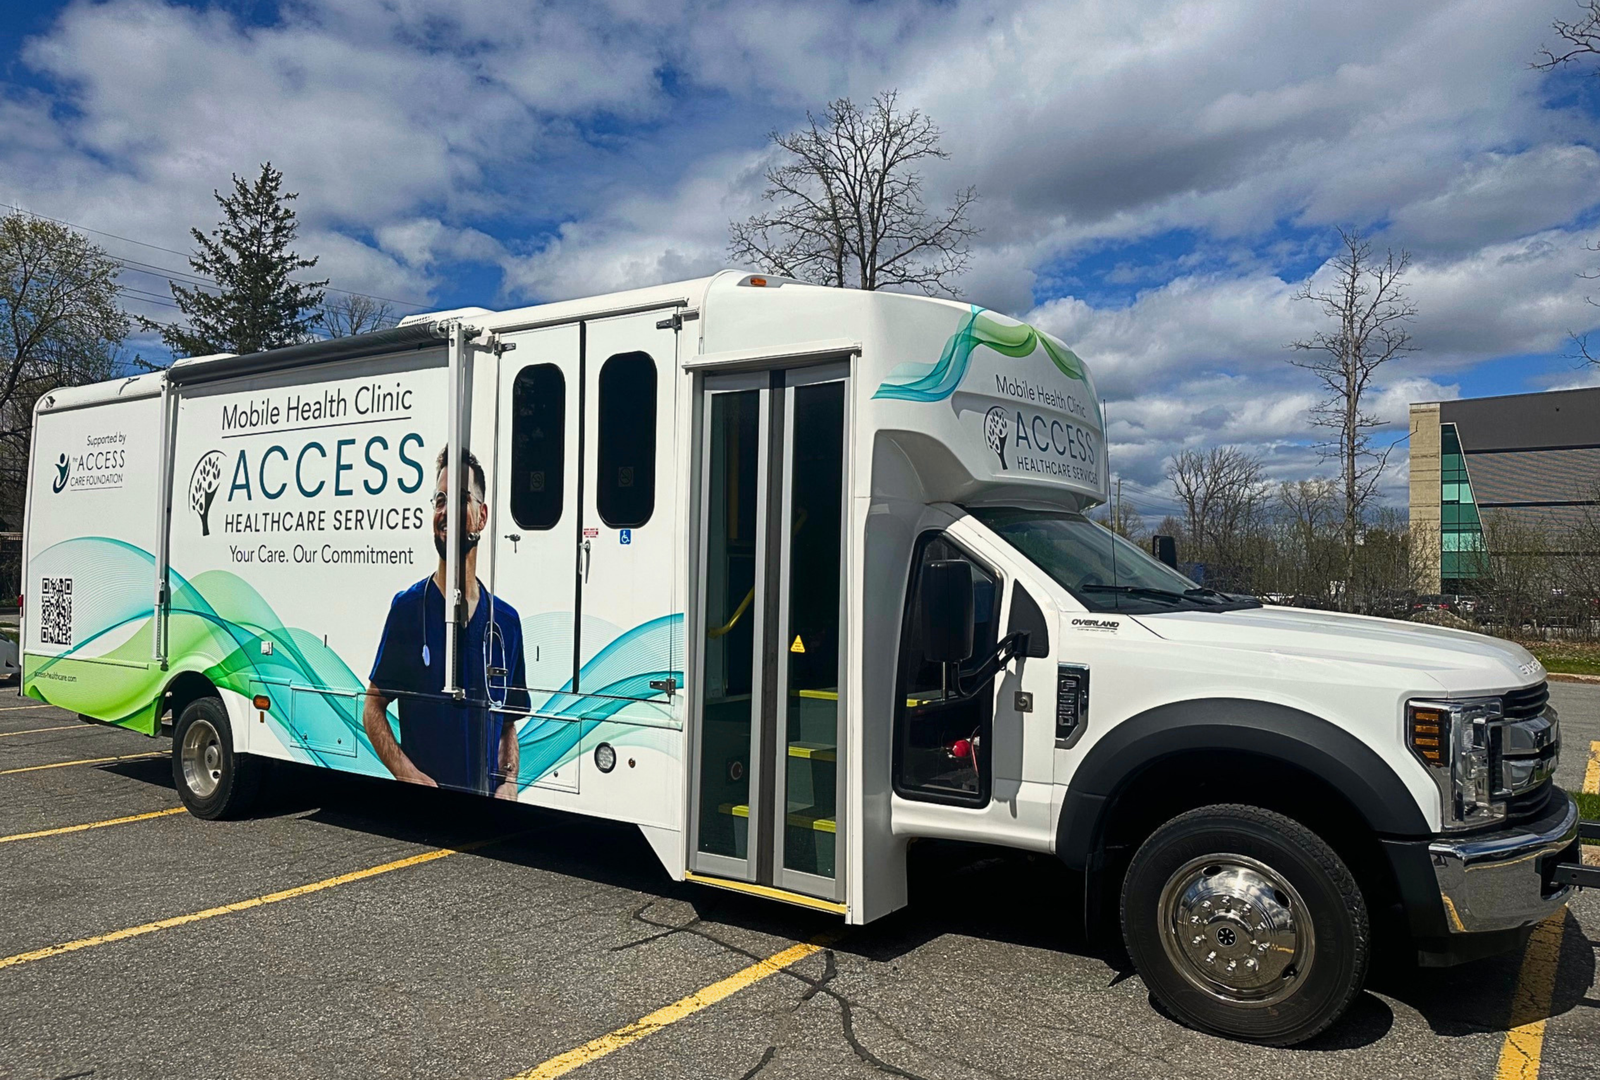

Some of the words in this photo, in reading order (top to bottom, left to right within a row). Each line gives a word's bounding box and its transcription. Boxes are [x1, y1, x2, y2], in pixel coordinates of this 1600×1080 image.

[222, 398, 280, 431] Mobile
[286, 388, 347, 423] Health
[355, 382, 413, 415] Clinic
[996, 374, 1035, 400] Mobile
[1037, 384, 1066, 410] Health
[1067, 395, 1086, 418] Clinic
[87, 431, 118, 448] Supported
[119, 430, 127, 445] by
[1016, 411, 1095, 465] ACCESS
[77, 449, 125, 471] ACCESS
[228, 433, 424, 502] ACCESS
[1016, 456, 1071, 478] HEALTHCARE
[1072, 465, 1098, 485] SERVICES
[70, 475, 85, 486] CARE
[86, 473, 123, 485] FOUNDATION
[225, 510, 326, 533] HEALTHCARE
[333, 508, 424, 531] SERVICES
[229, 545, 255, 563] Your
[257, 544, 289, 563] Care.
[293, 544, 317, 563] Our
[321, 544, 414, 564] Commitment
[1071, 618, 1120, 628] OVERLAND
